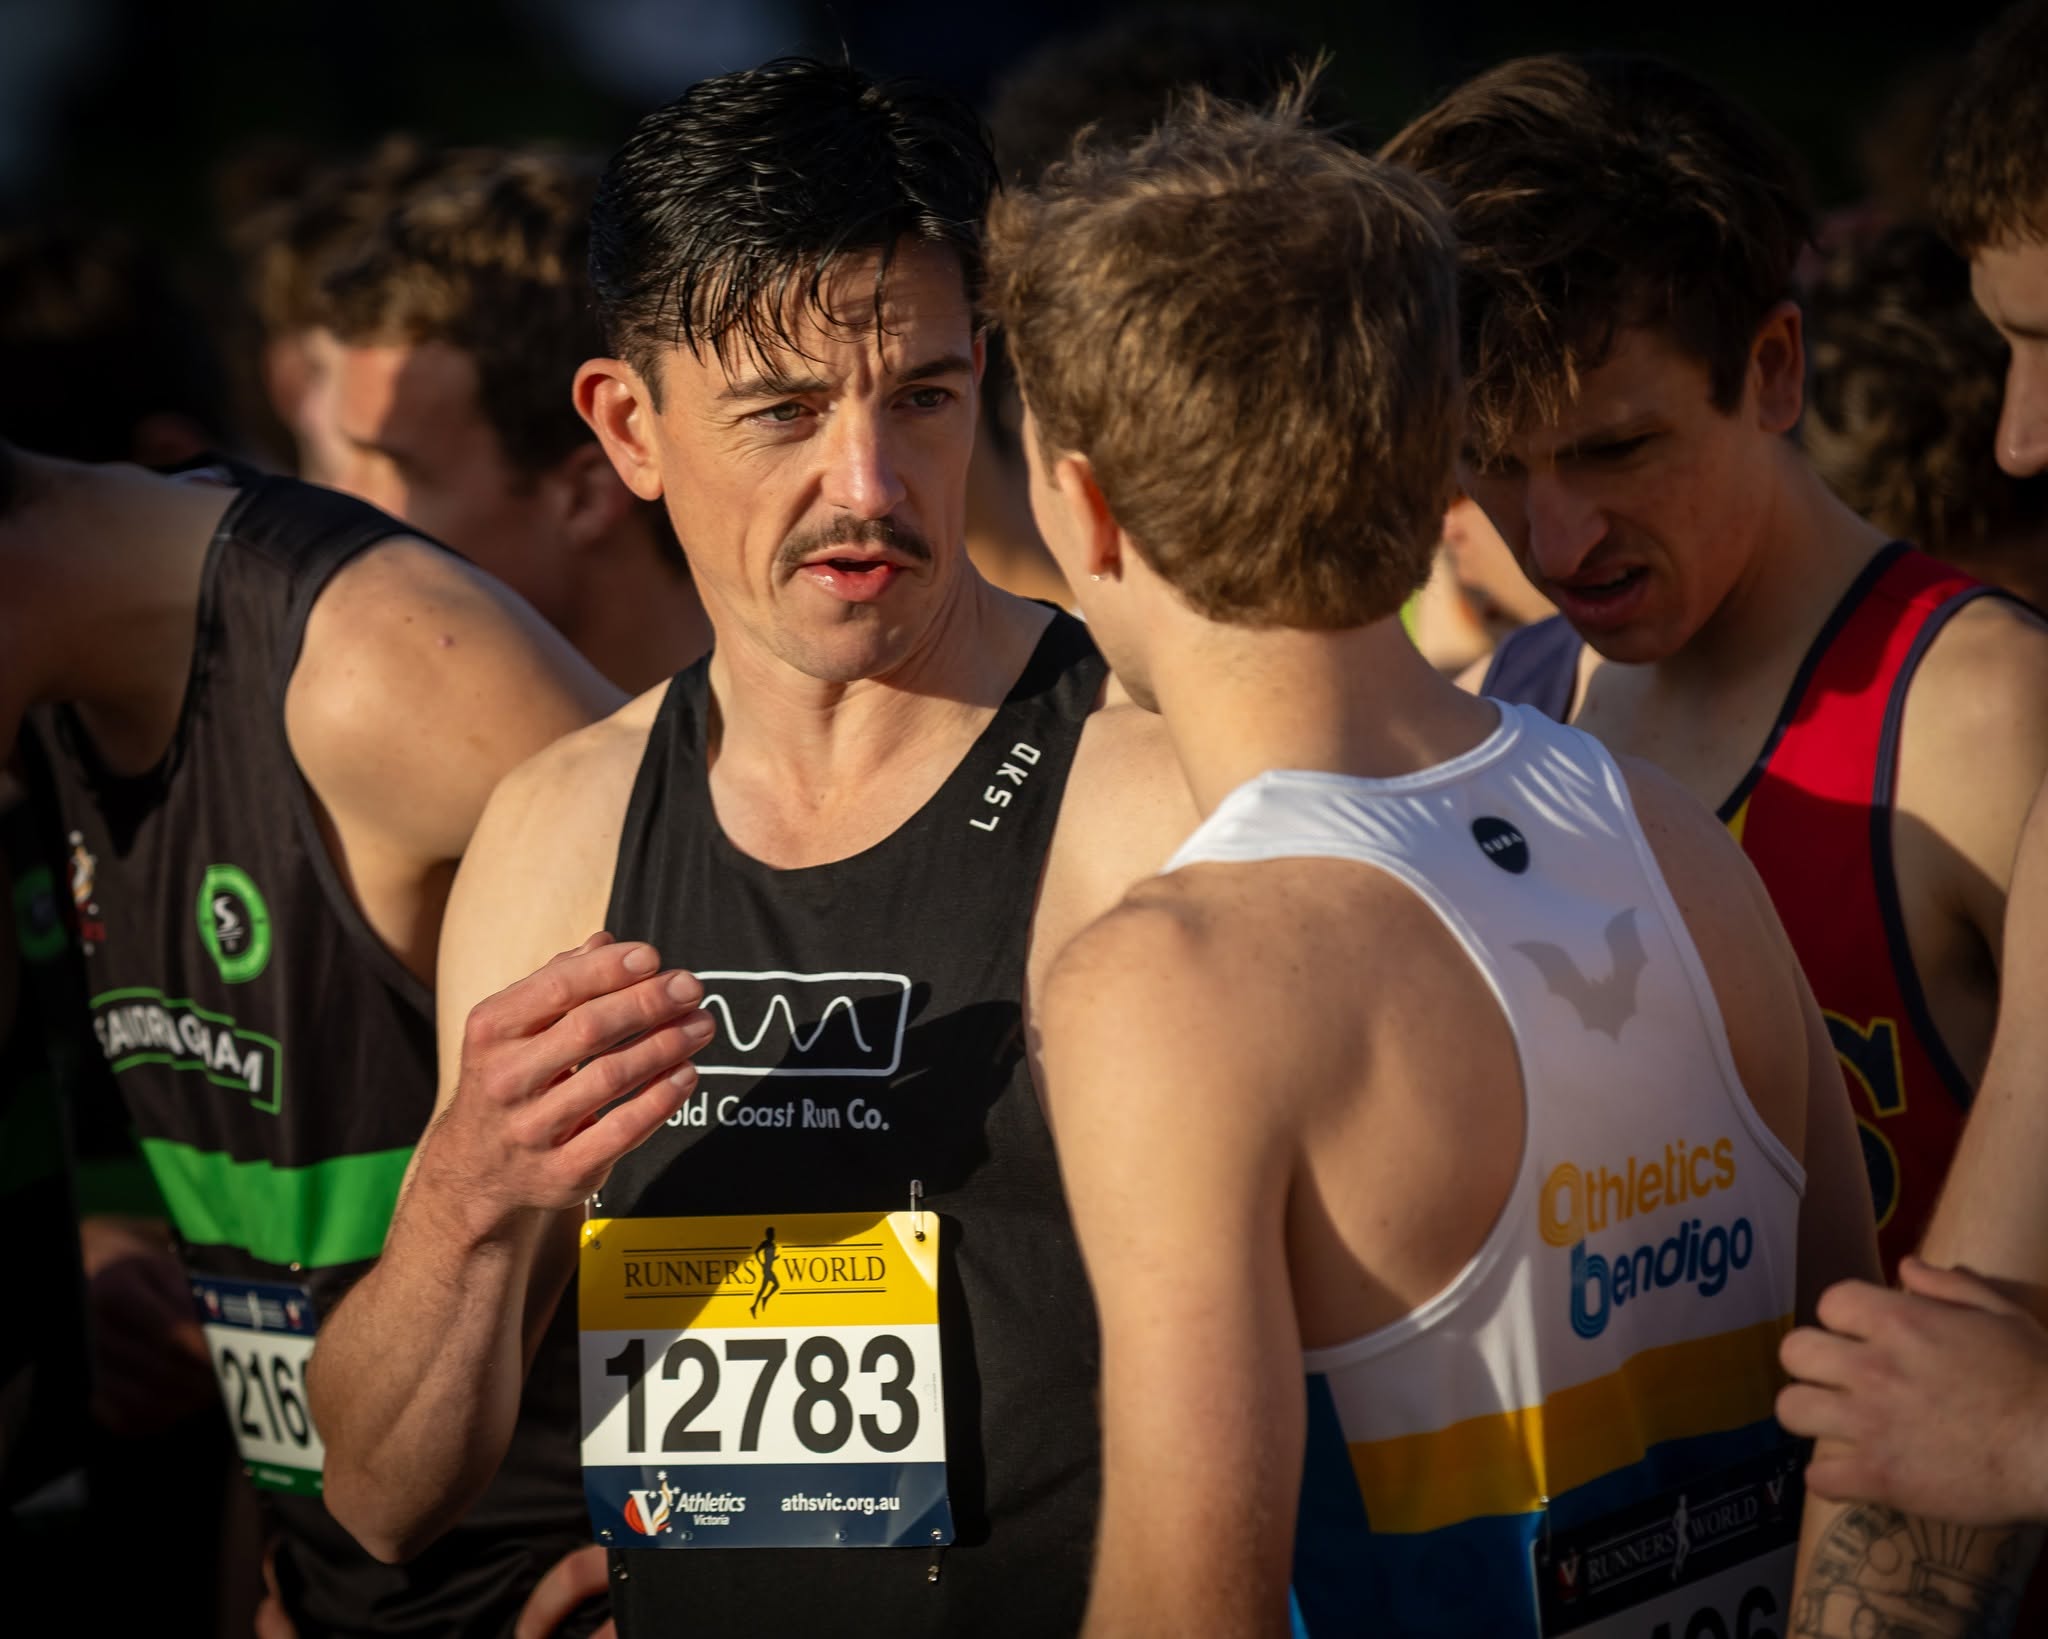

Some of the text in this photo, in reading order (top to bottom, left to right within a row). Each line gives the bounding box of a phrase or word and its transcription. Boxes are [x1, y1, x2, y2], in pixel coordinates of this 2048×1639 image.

[664, 1091, 890, 1131] old Coast Run Co.
[623, 1255, 886, 1288] RUNNERS WORLD
[1569, 1217, 1753, 1340] bendigo
[221, 1348, 311, 1450] 216
[605, 1334, 920, 1454] 12783
[675, 1492, 900, 1516] Athletics athsvic.org.au
[693, 1513, 730, 1526] Victoria
[1690, 1494, 1759, 1540] WORLD
